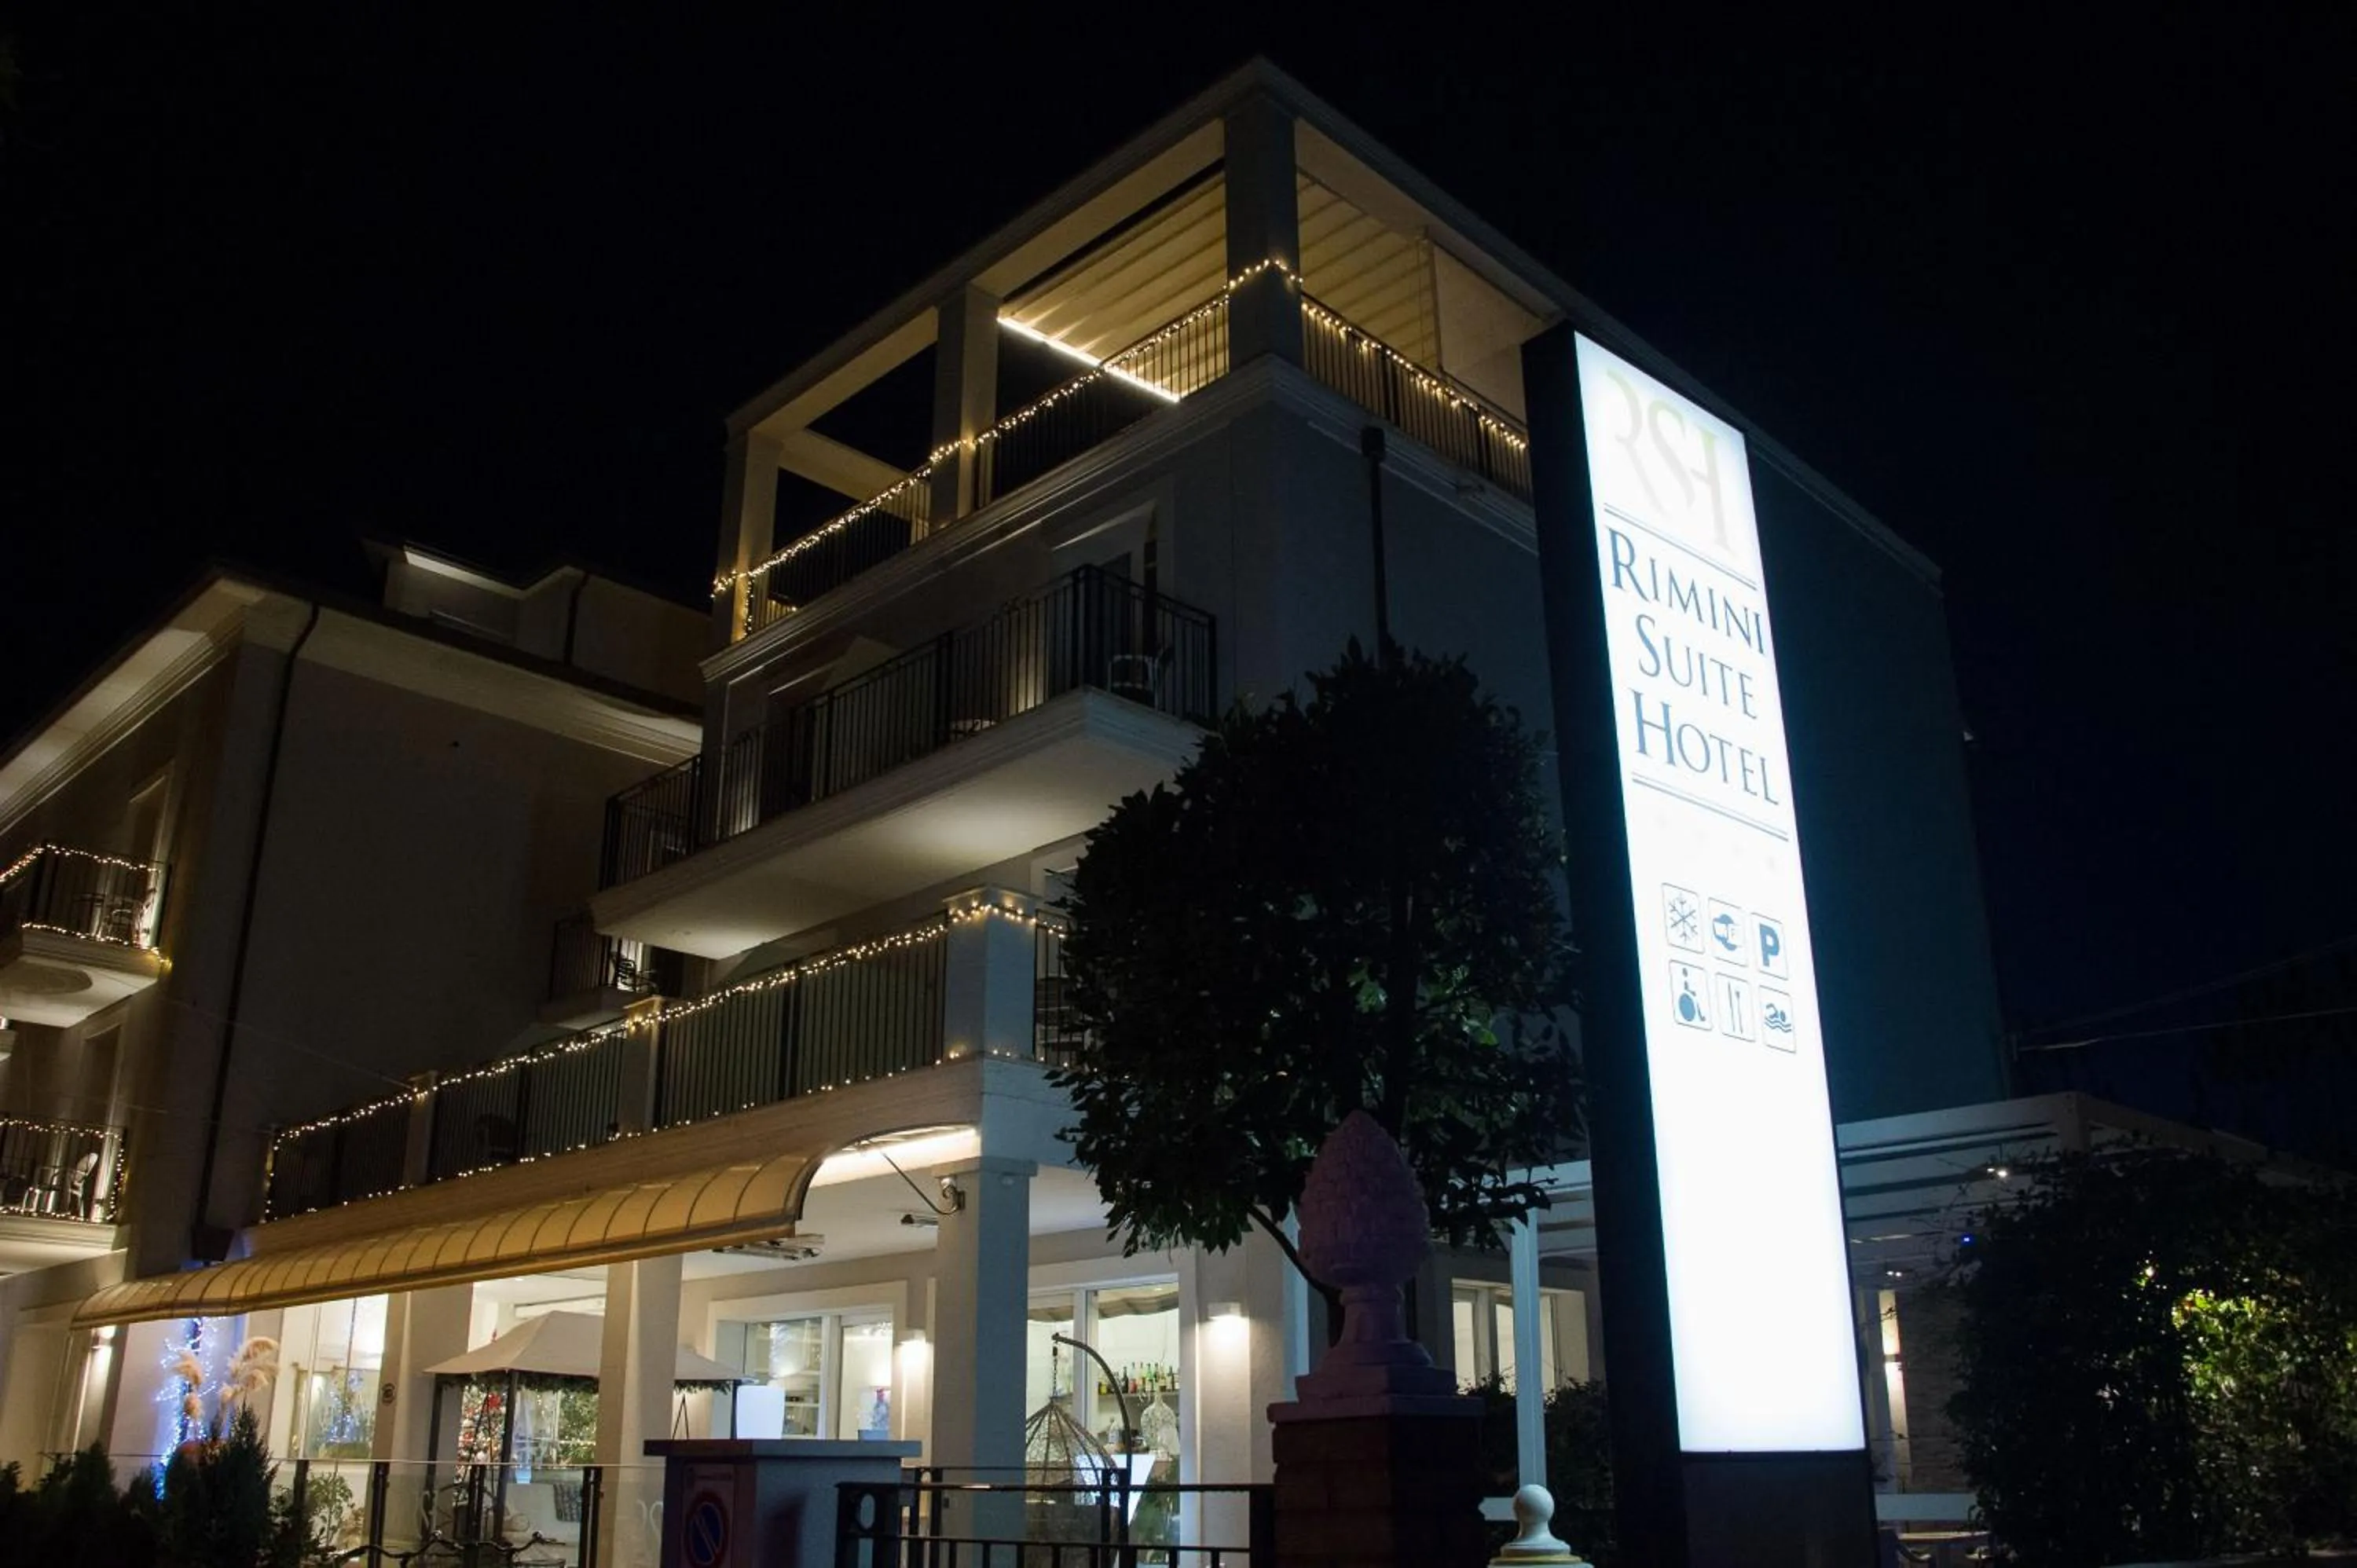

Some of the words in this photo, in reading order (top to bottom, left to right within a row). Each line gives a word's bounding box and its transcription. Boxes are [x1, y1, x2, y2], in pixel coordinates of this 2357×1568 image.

[1607, 527, 1765, 655] RIMINI
[1636, 614, 1758, 720] SUITE
[1629, 687, 1780, 805] HOTEL
